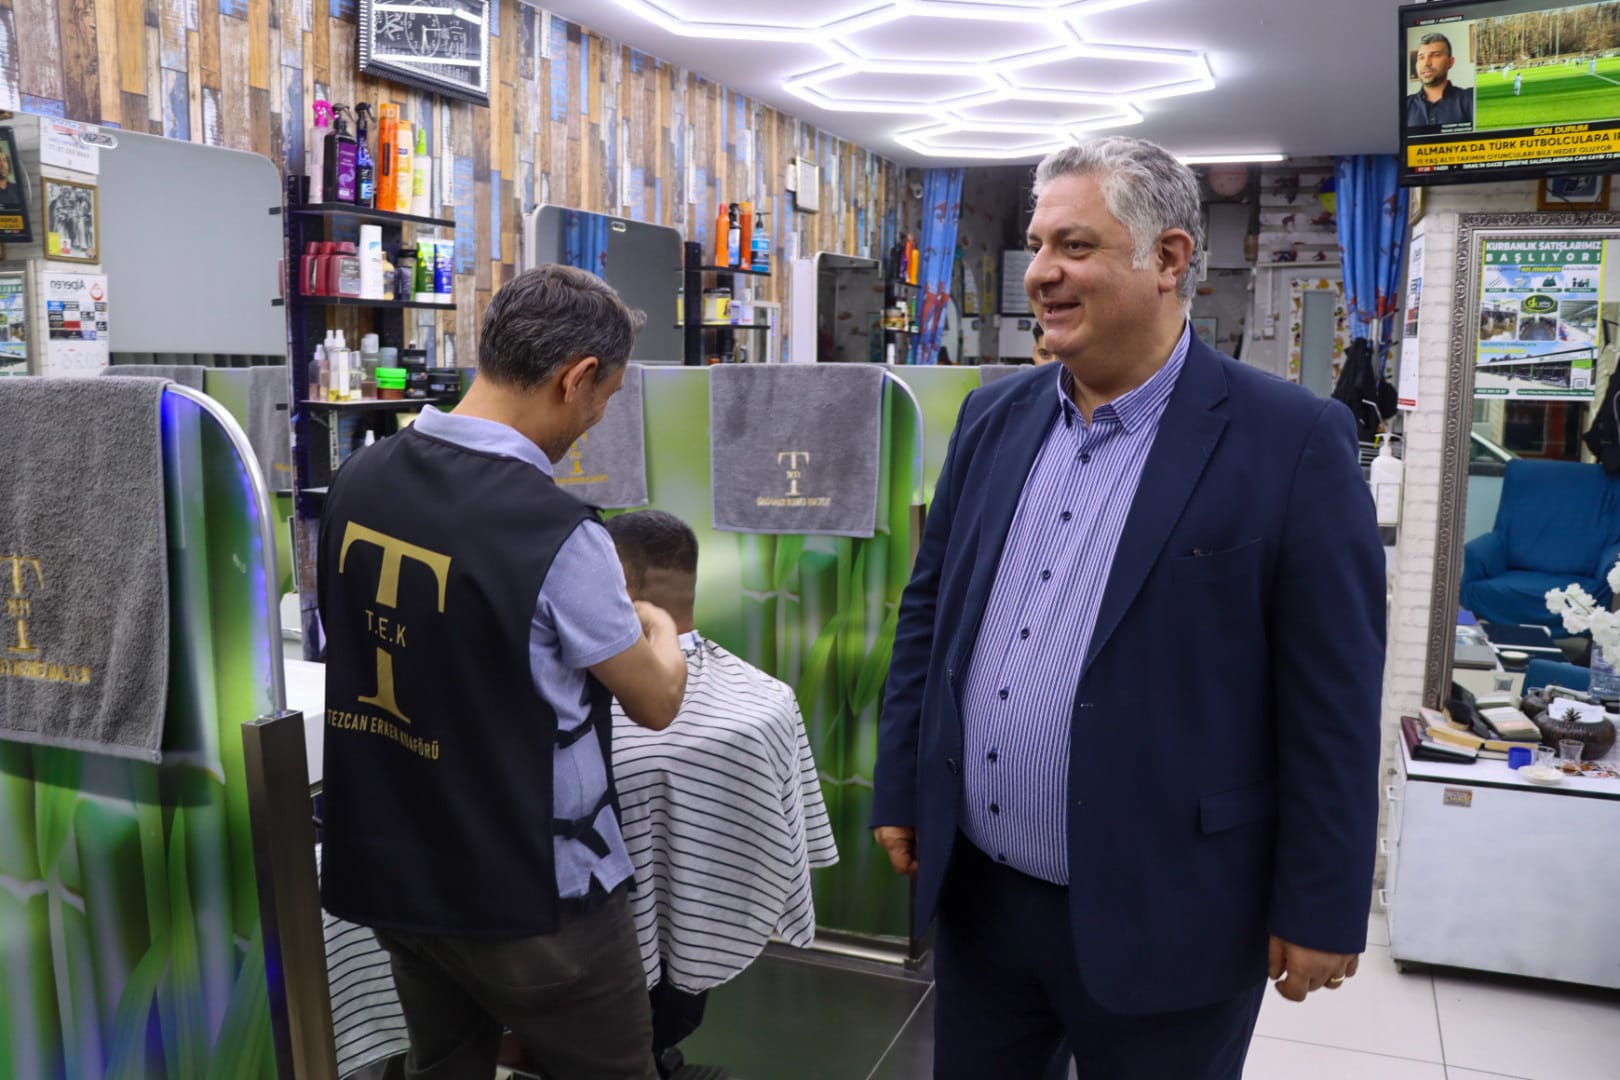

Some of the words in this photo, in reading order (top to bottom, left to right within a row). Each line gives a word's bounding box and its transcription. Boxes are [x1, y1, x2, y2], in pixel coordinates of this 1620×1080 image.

[1533, 127, 1552, 136] SON
[1554, 124, 1589, 134] DURUM
[1416, 143, 1485, 156] ALMANYA'DA
[1489, 140, 1517, 151] TÜRK
[1519, 133, 1610, 148] FUTBOLCULARA
[1553, 147, 1577, 155] HEDEF
[1579, 144, 1613, 153] OLUYOR
[1486, 241, 1537, 251] KURBANLIK
[1538, 241, 1602, 252] SATIŞLARIMIZ
[1485, 252, 1601, 264] BAŞLIYOR!
[365, 609, 407, 648] T.E.K
[327, 709, 368, 731] TEZCAN
